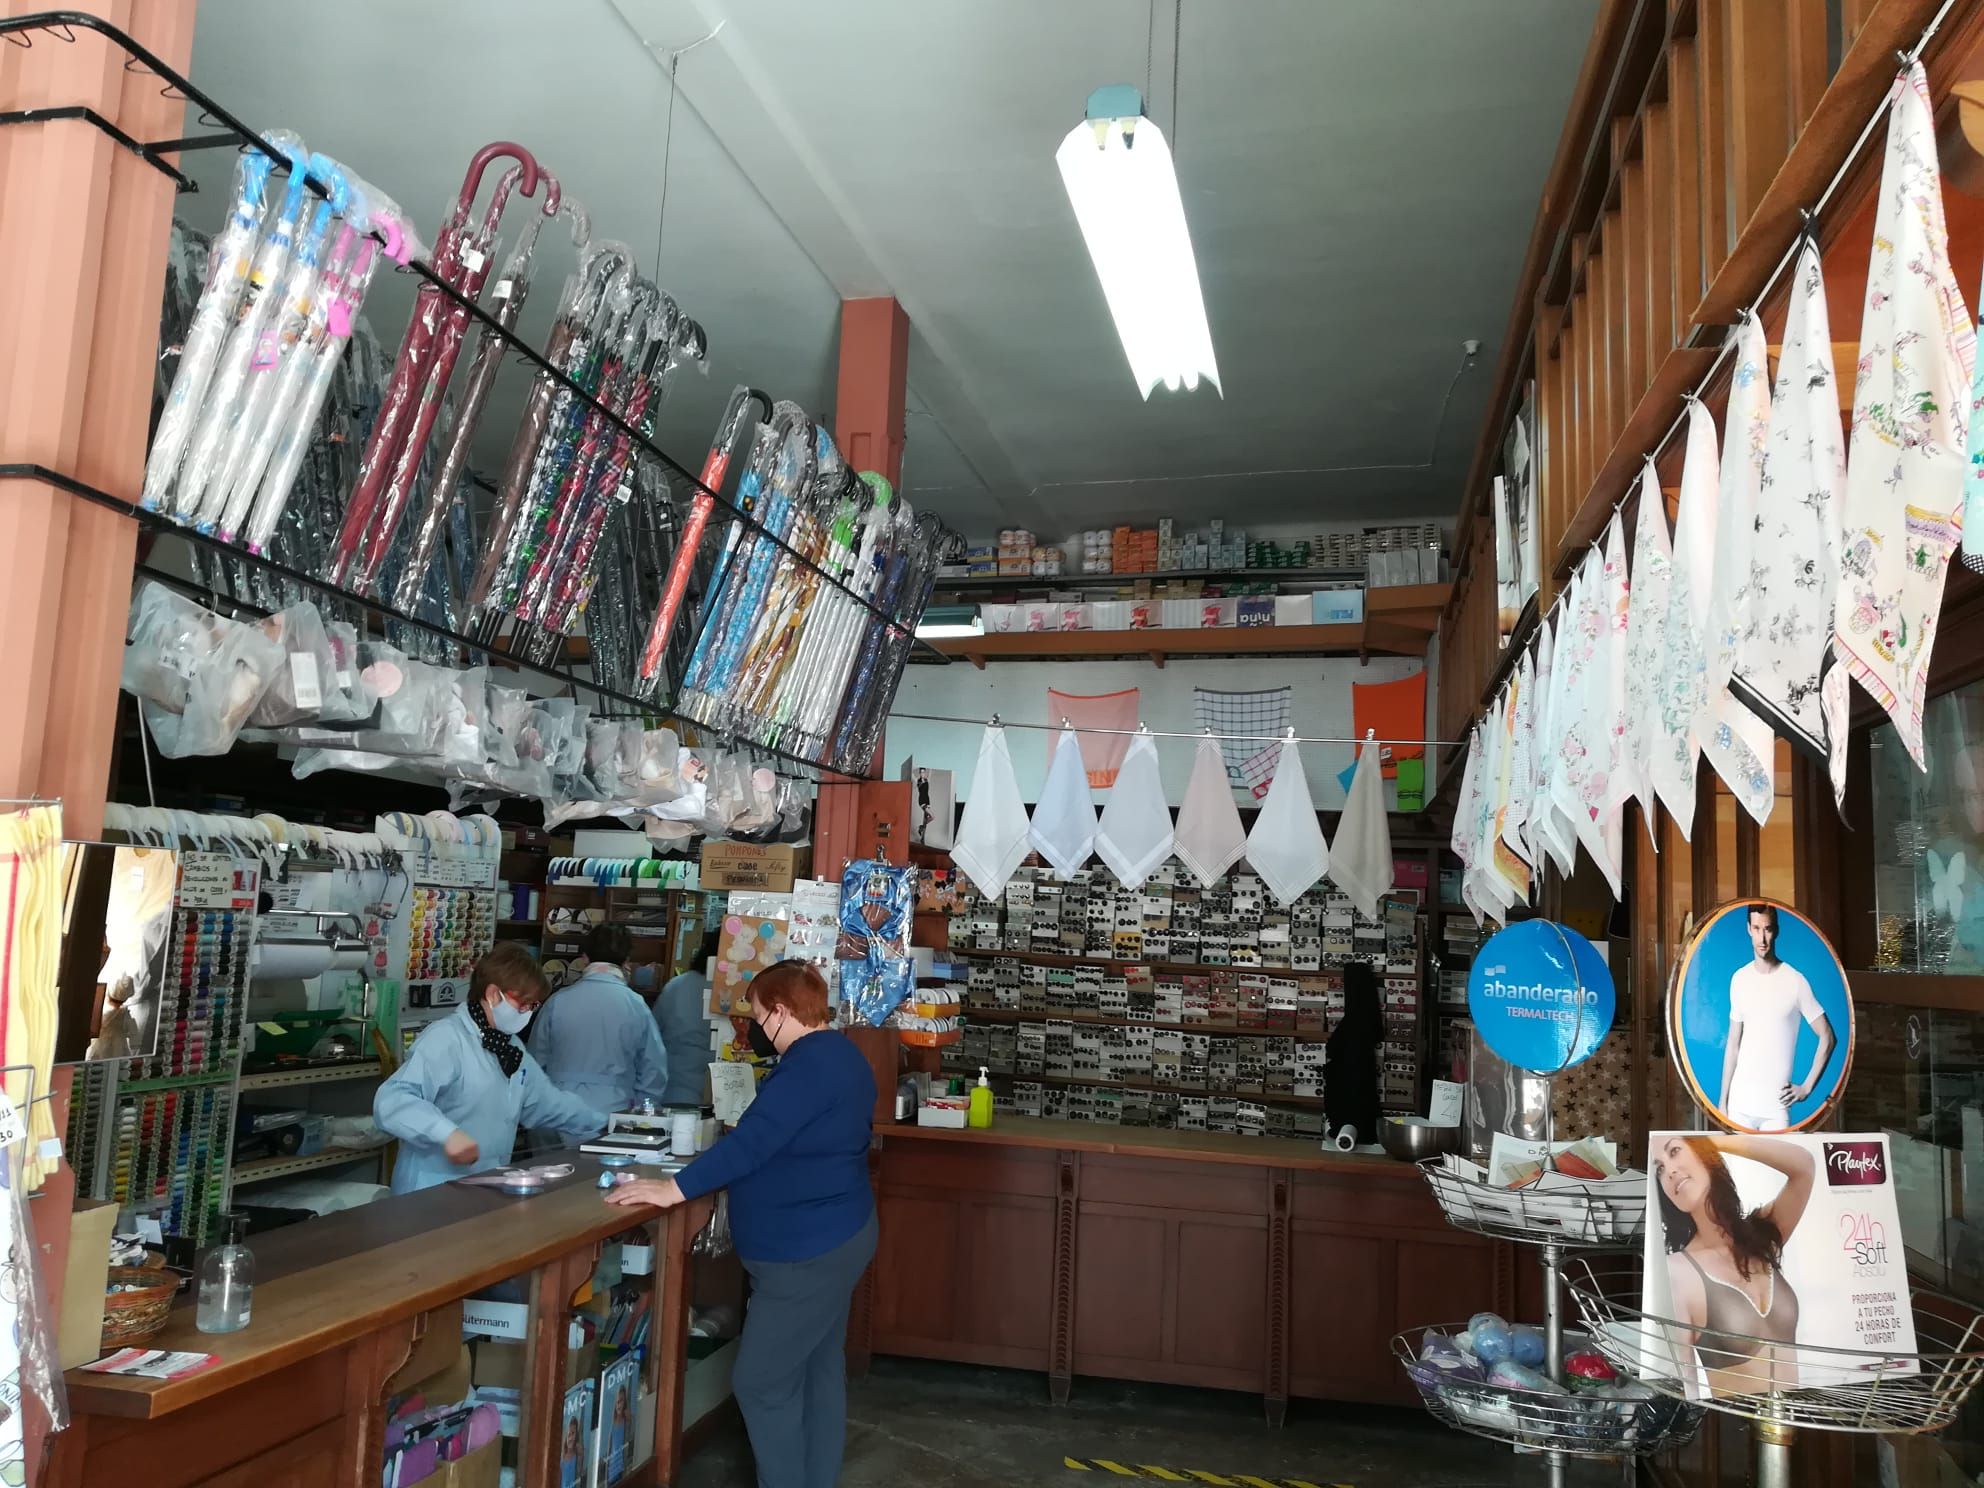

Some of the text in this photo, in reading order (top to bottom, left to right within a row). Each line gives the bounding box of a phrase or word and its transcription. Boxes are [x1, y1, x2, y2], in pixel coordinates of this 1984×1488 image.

[1240, 612, 1270, 627] niña
[1484, 980, 1598, 1005] abanderado
[1828, 1150, 1882, 1179] Playtex
[1850, 1241, 1888, 1265] Soft
[1851, 1292, 1896, 1304] PROPORCIONA
[1858, 1306, 1895, 1318] A TU PECHO
[462, 1314, 510, 1329] ütermann
[1855, 1317, 1901, 1332] 24 HORAS DE
[1864, 1331, 1896, 1344] CONFORT
[607, 1361, 634, 1390] DMC
[563, 1391, 586, 1416] MC
